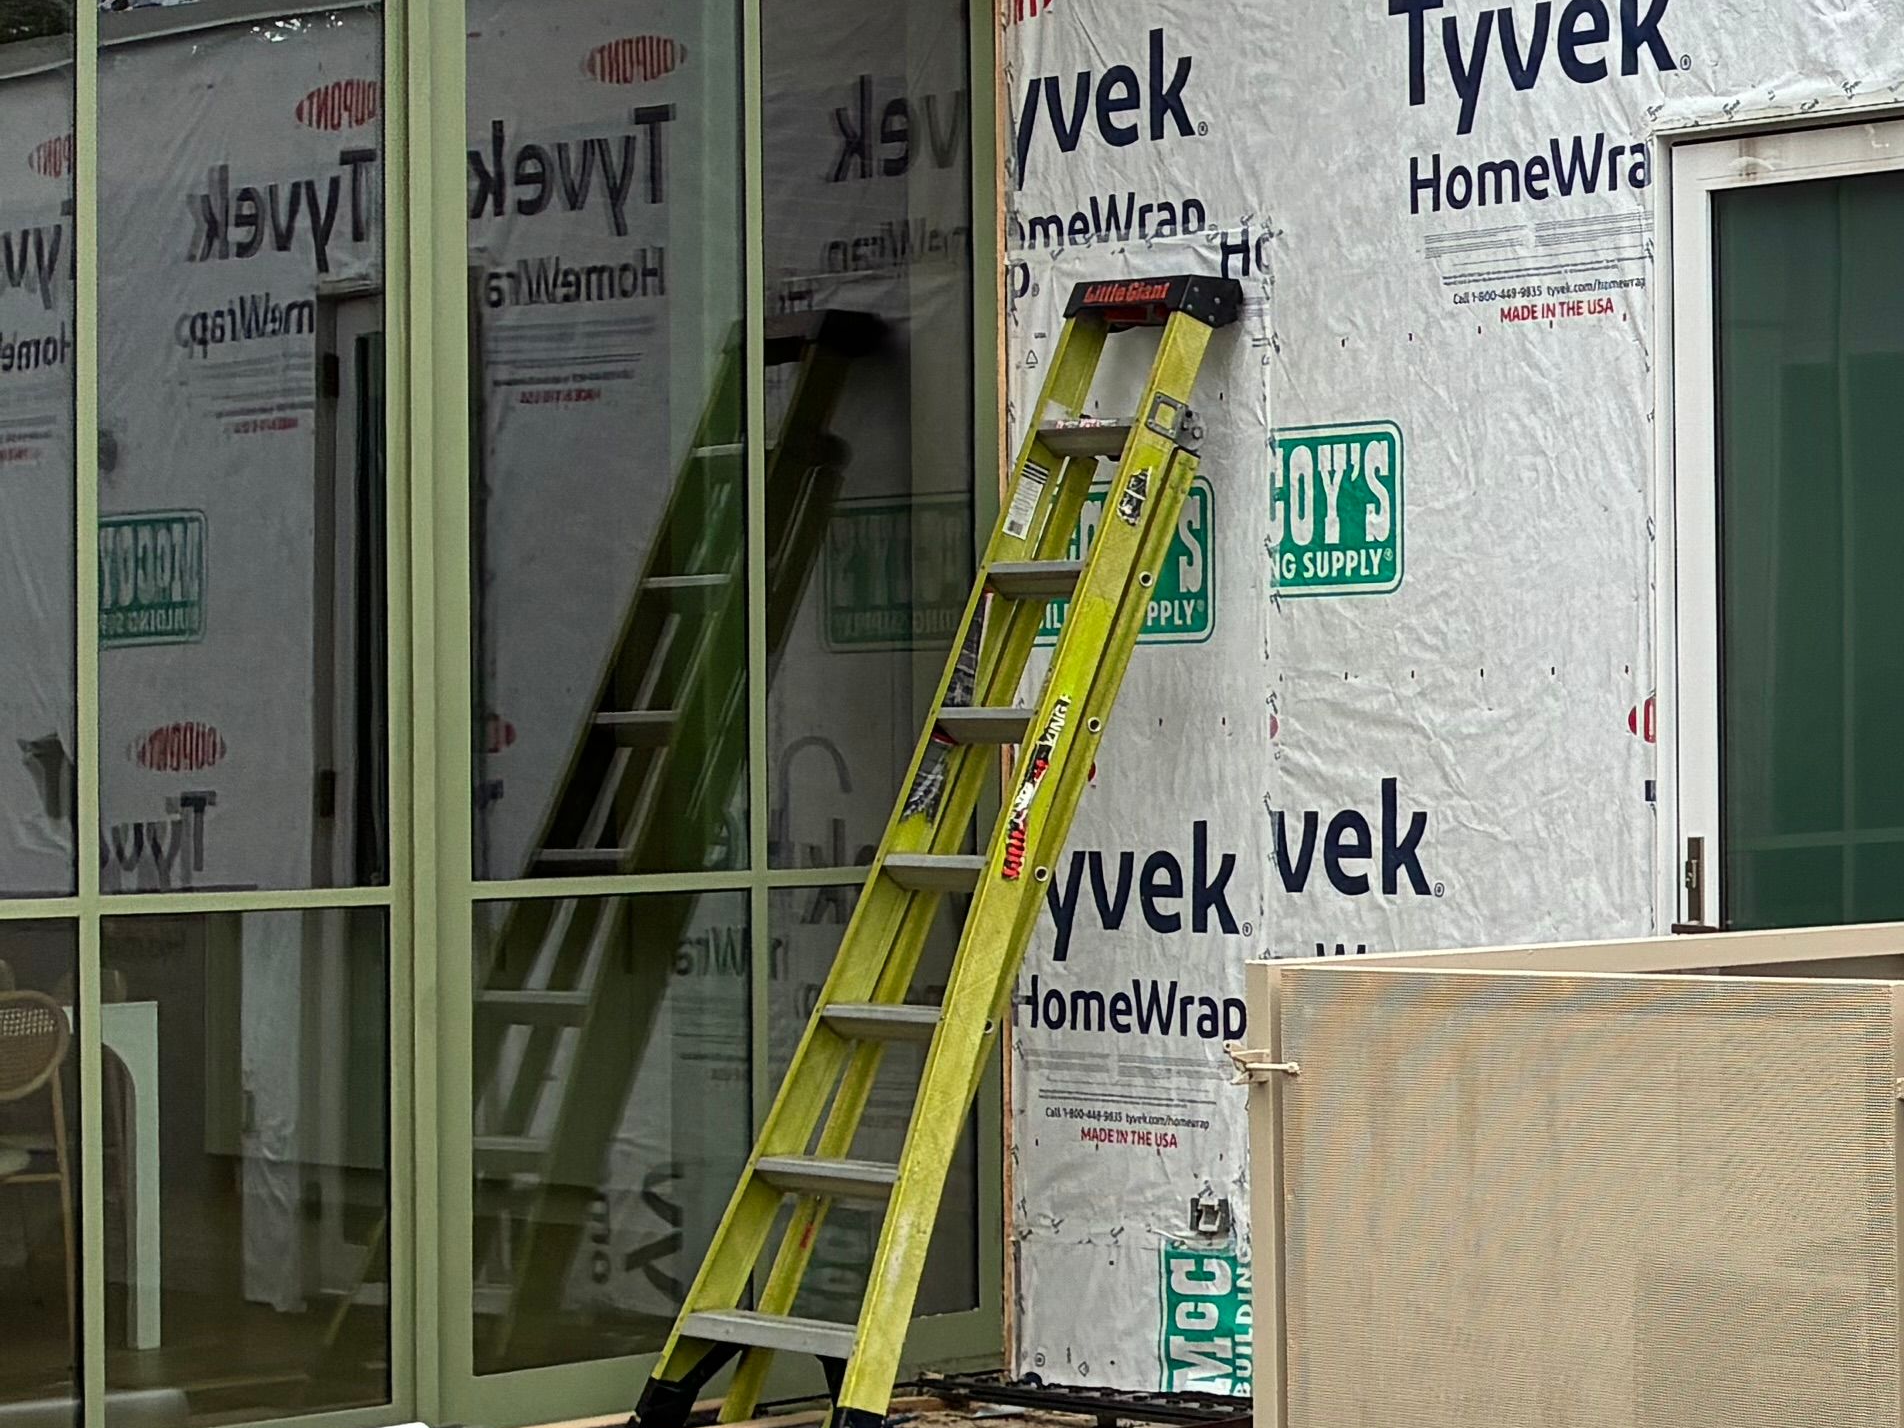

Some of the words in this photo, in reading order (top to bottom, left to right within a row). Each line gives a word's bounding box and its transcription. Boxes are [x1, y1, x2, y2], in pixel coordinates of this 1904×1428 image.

[1017, 27, 1195, 191] yvek
[1410, 132, 1649, 214] HomeWra
[1016, 191, 1206, 250] meWrap
[1500, 305, 1538, 323] MADE
[1542, 302, 1558, 319] IN
[1558, 300, 1584, 317] THE
[1588, 297, 1614, 315] USA
[1303, 549, 1382, 579] SUPPLY
[1147, 599, 1195, 626] PPLY
[1276, 777, 1431, 896] vek
[1047, 820, 1239, 961] yvek
[1080, 1127, 1115, 1145] MADE
[1116, 1129, 1128, 1145] IN
[1130, 1131, 1152, 1147] THE
[1155, 1132, 1178, 1149] USA
